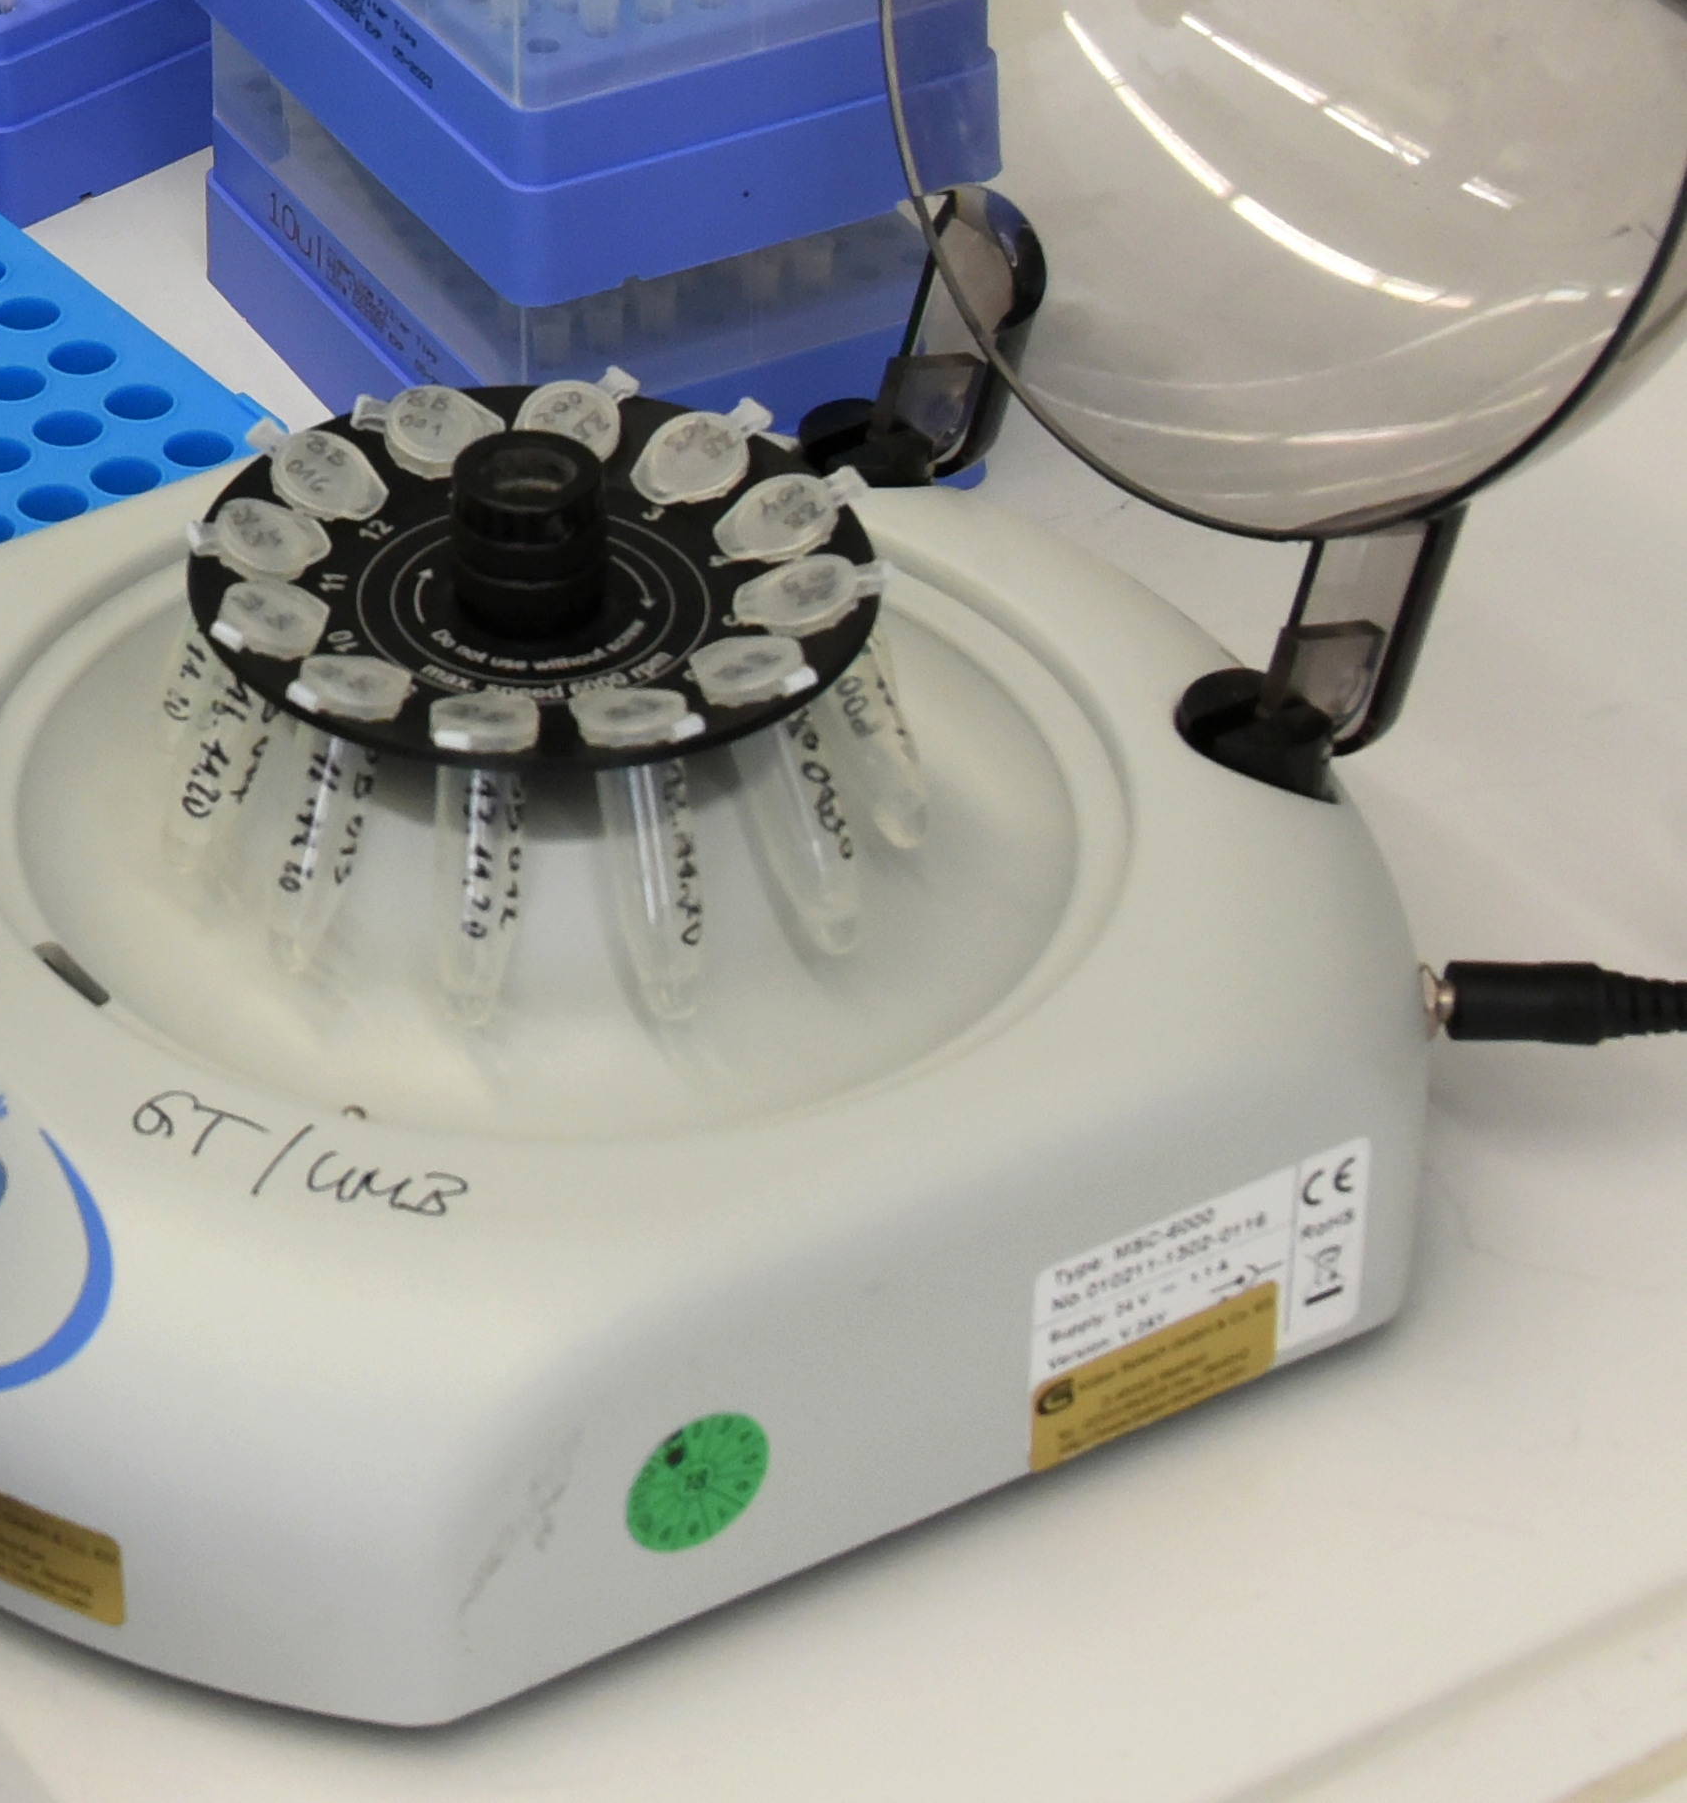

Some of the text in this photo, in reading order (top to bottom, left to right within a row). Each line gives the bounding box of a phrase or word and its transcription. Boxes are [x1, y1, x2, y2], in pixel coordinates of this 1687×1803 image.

[358, 519, 394, 541] 12
[319, 571, 348, 592] 11
[327, 628, 358, 653] 10
[430, 628, 456, 649] Do
[458, 644, 488, 663] not
[490, 656, 527, 671] use
[532, 647, 607, 671] without
[420, 663, 475, 692] max.
[630, 651, 675, 679] rpm
